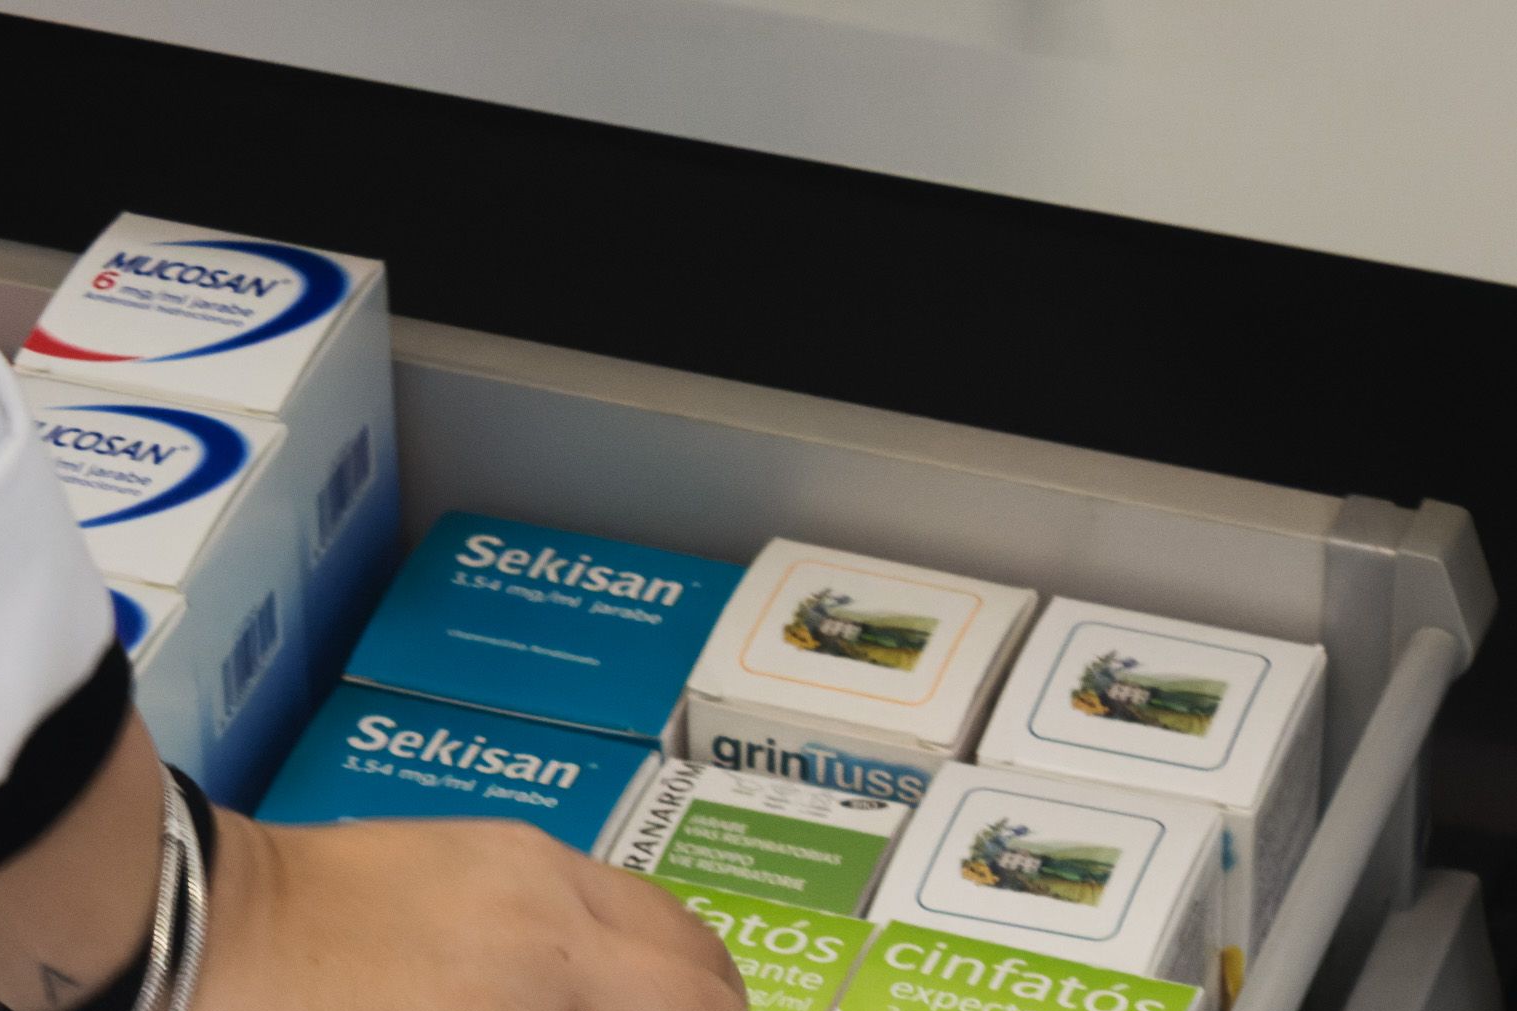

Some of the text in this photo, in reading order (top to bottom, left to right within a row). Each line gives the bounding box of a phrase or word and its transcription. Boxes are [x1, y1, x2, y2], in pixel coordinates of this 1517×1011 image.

[92, 271, 116, 291] 6
[104, 250, 281, 299] MUCOSAN
[33, 420, 176, 465] COSAN
[456, 534, 684, 606] Sekisan
[346, 714, 581, 789] Sekisan
[711, 734, 927, 806] grinTuss
[624, 760, 706, 871] RANARÔM
[687, 896, 845, 965] atós
